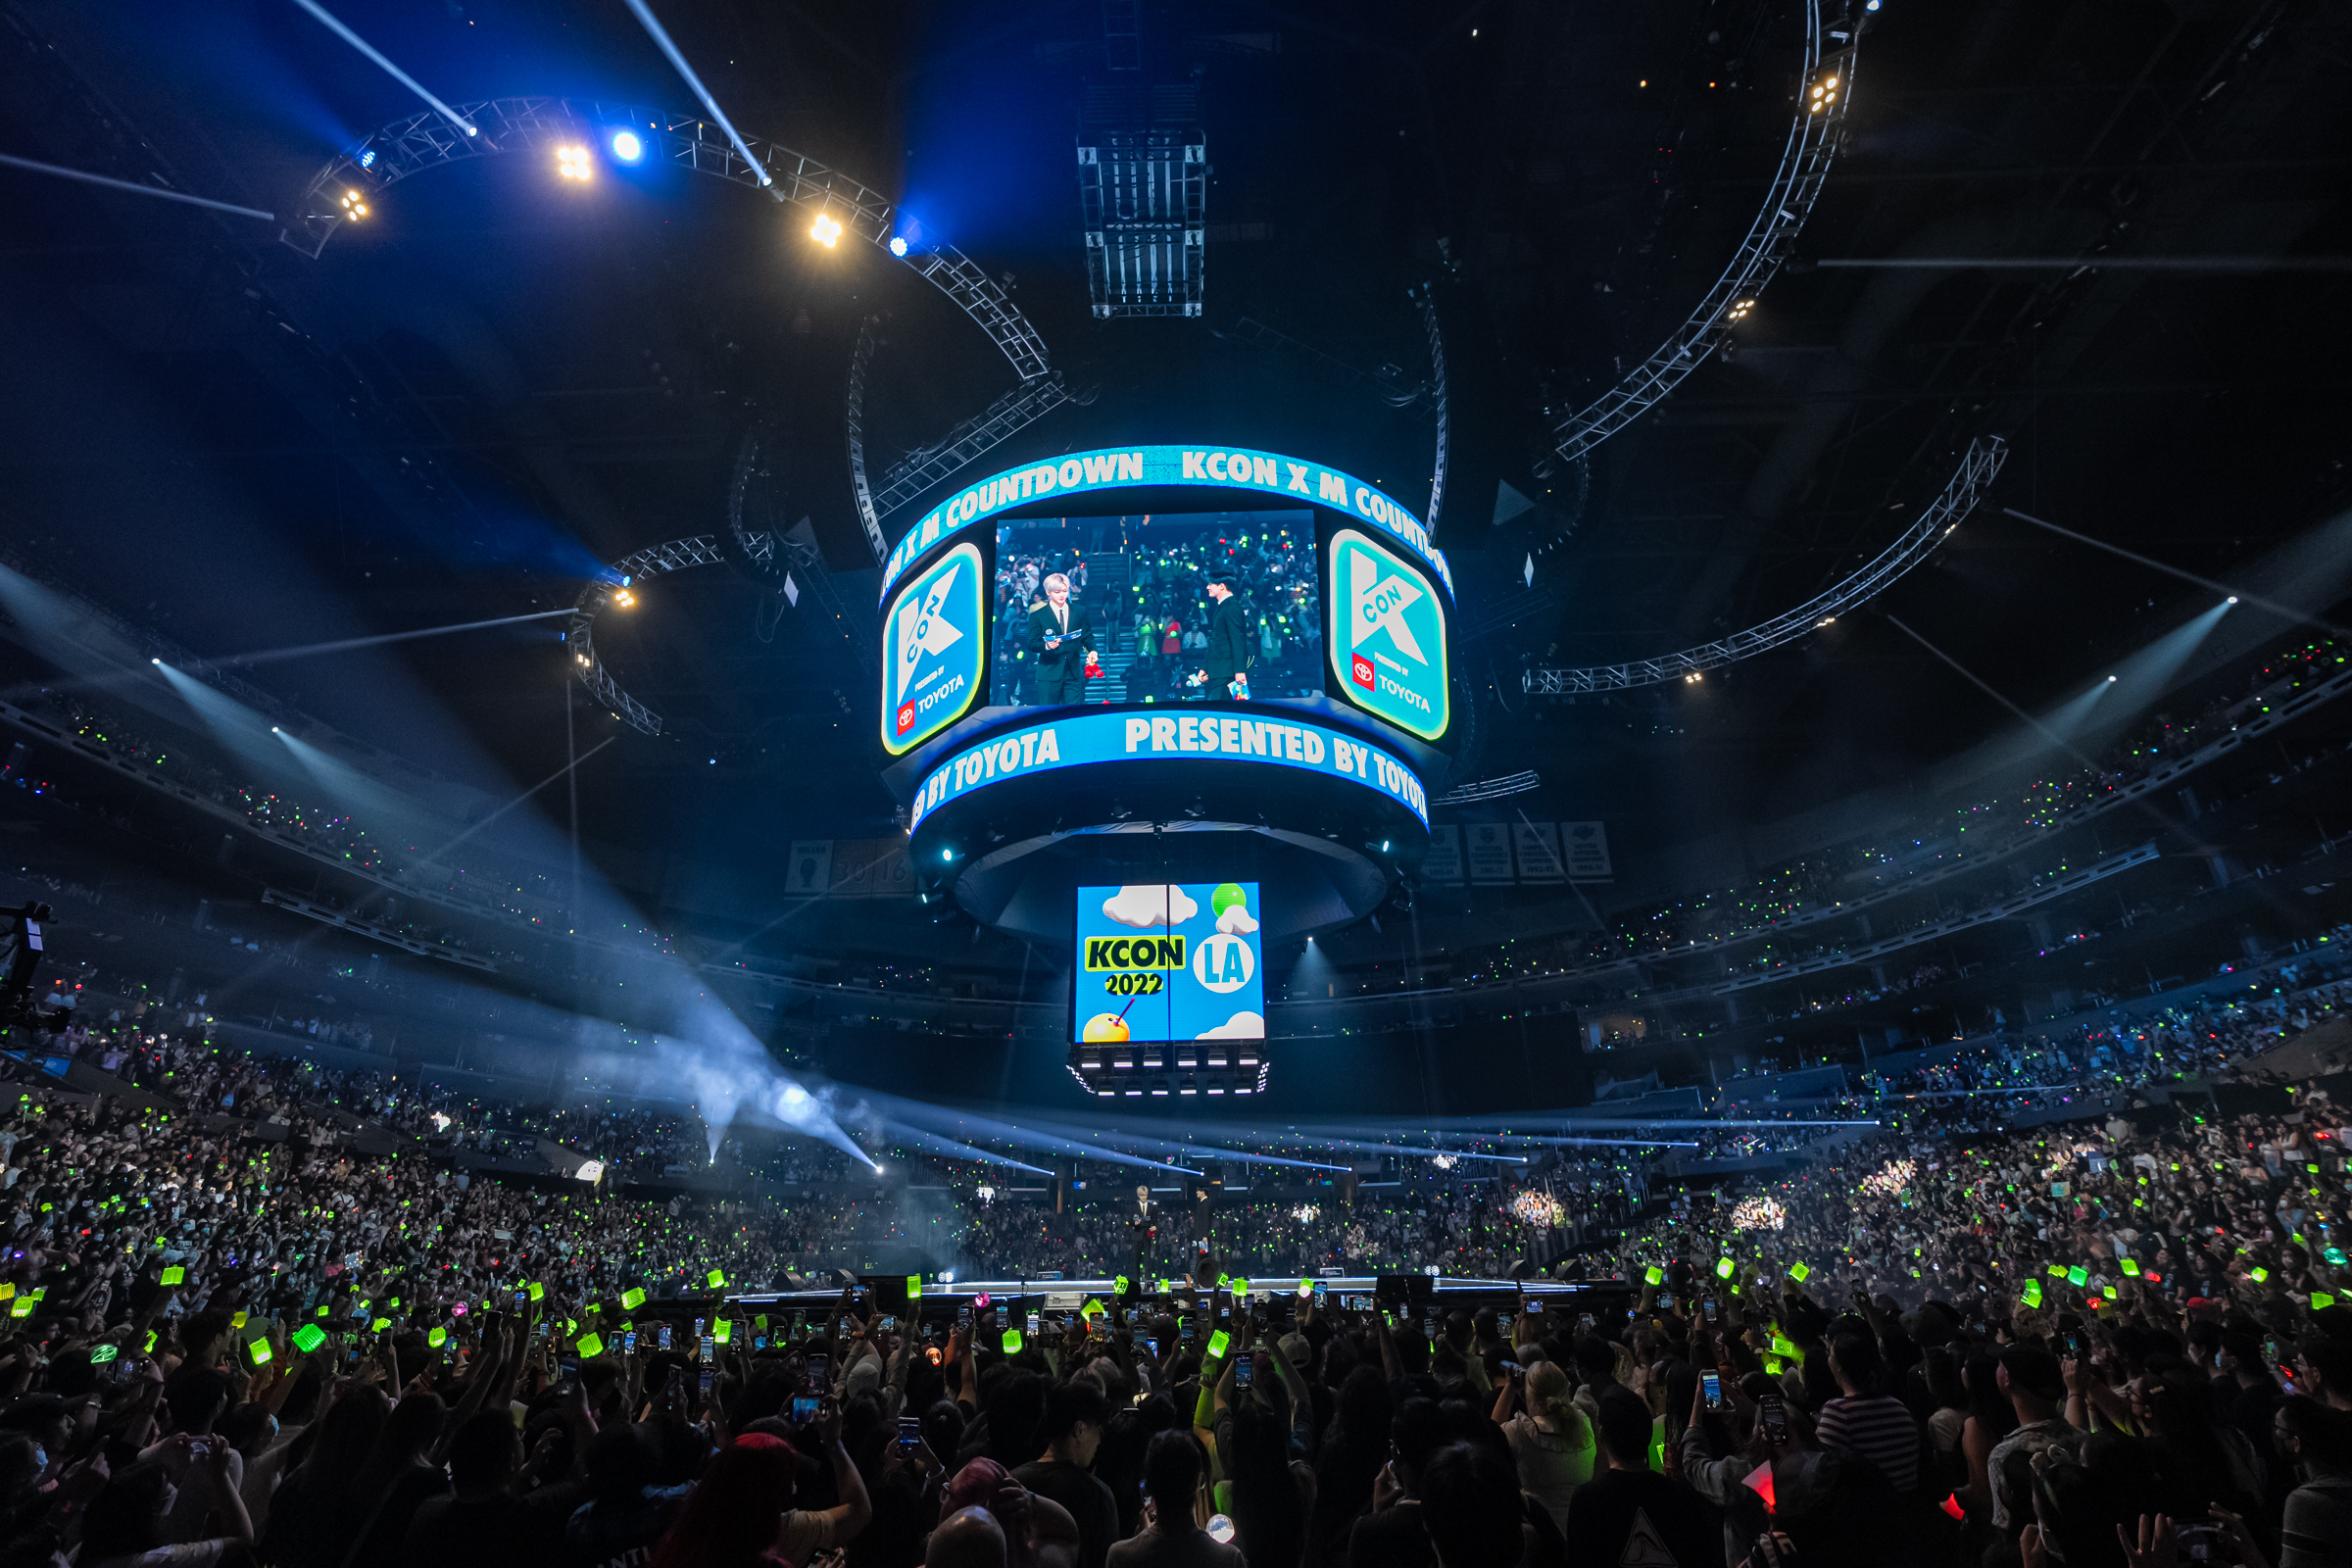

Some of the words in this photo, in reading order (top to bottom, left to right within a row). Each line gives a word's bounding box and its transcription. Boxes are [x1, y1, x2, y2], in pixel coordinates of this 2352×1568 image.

[1182, 451, 1278, 487] KCON
[1286, 463, 1311, 494] X
[1319, 472, 1348, 507] M
[904, 530, 917, 564] X
[919, 513, 940, 549] M
[947, 452, 1143, 528] COUNTDOWN
[1362, 584, 1402, 623] CON
[906, 594, 940, 664] CON
[917, 673, 965, 713] TOYOTA
[1378, 673, 1431, 713] TOYOTA
[927, 765, 952, 809] BY
[955, 728, 1060, 791] TOYOTA
[1125, 717, 1325, 764] PRESENTED
[1334, 737, 1369, 779] BY
[1087, 938, 1184, 968] KCON
[1203, 942, 1246, 984] LA
[1104, 973, 1164, 996] 2022
